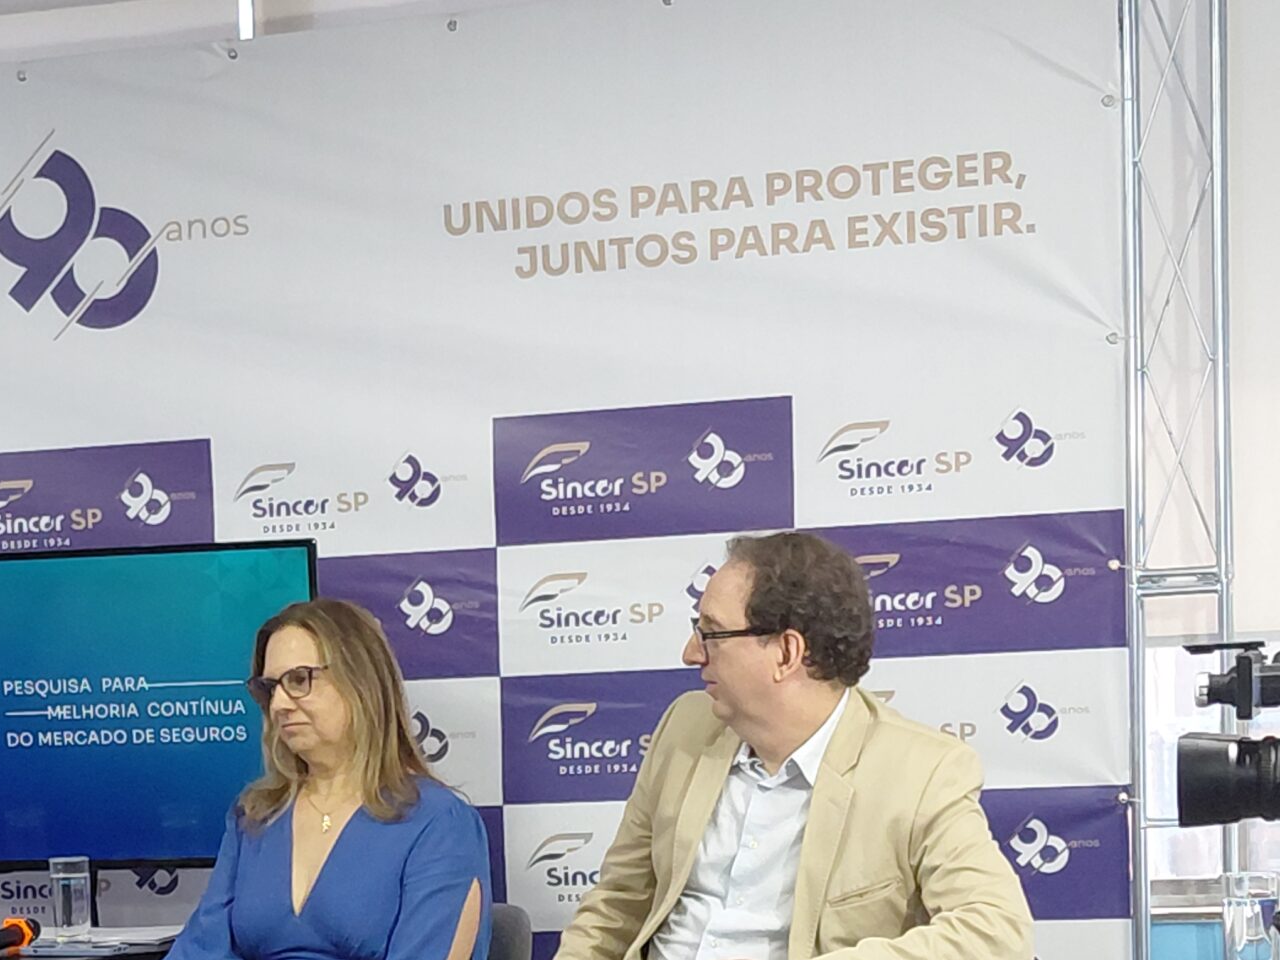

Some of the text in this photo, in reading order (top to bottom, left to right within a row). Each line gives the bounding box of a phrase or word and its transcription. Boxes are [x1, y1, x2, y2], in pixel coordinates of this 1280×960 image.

[443, 150, 1027, 236] UNIDOS PARA PROTEGER,
[165, 212, 250, 243] anos
[515, 201, 1037, 279] JUNTOS PARA EXISTIR.
[995, 411, 1055, 467] 90
[688, 432, 746, 488] 90
[838, 451, 972, 480] Sincor SP
[389, 454, 441, 508] 90
[540, 471, 667, 500] Sincor SP
[850, 483, 933, 497] DESDE 1934
[121, 472, 171, 526] 90
[252, 491, 369, 518] Sincor SP
[552, 502, 630, 516] DESDE 1934
[70, 508, 103, 530] SP
[263, 521, 336, 534] DESDE 1934
[2, 537, 71, 550] DESDE 1934
[1004, 545, 1065, 603] 90
[399, 580, 454, 635] 90
[944, 584, 982, 609] SP
[539, 602, 665, 629] Sincor SP
[878, 615, 943, 629] SDE 1934
[550, 632, 628, 645] DESDE 1934
[3, 675, 149, 698] PESQUISA PARA
[47, 696, 247, 721] MELHORIA CONTÍNUA
[999, 684, 1060, 741] 90
[7, 724, 248, 748] DO MERCADO DE SEGUROS
[548, 733, 652, 760] Sincor S
[559, 763, 638, 775] DESDE 1934
[1009, 818, 1070, 874] 90
[546, 866, 600, 887] Sinc
[0, 880, 53, 900] Sinc
[558, 894, 581, 903] DES
[11, 906, 46, 915] DESDE
